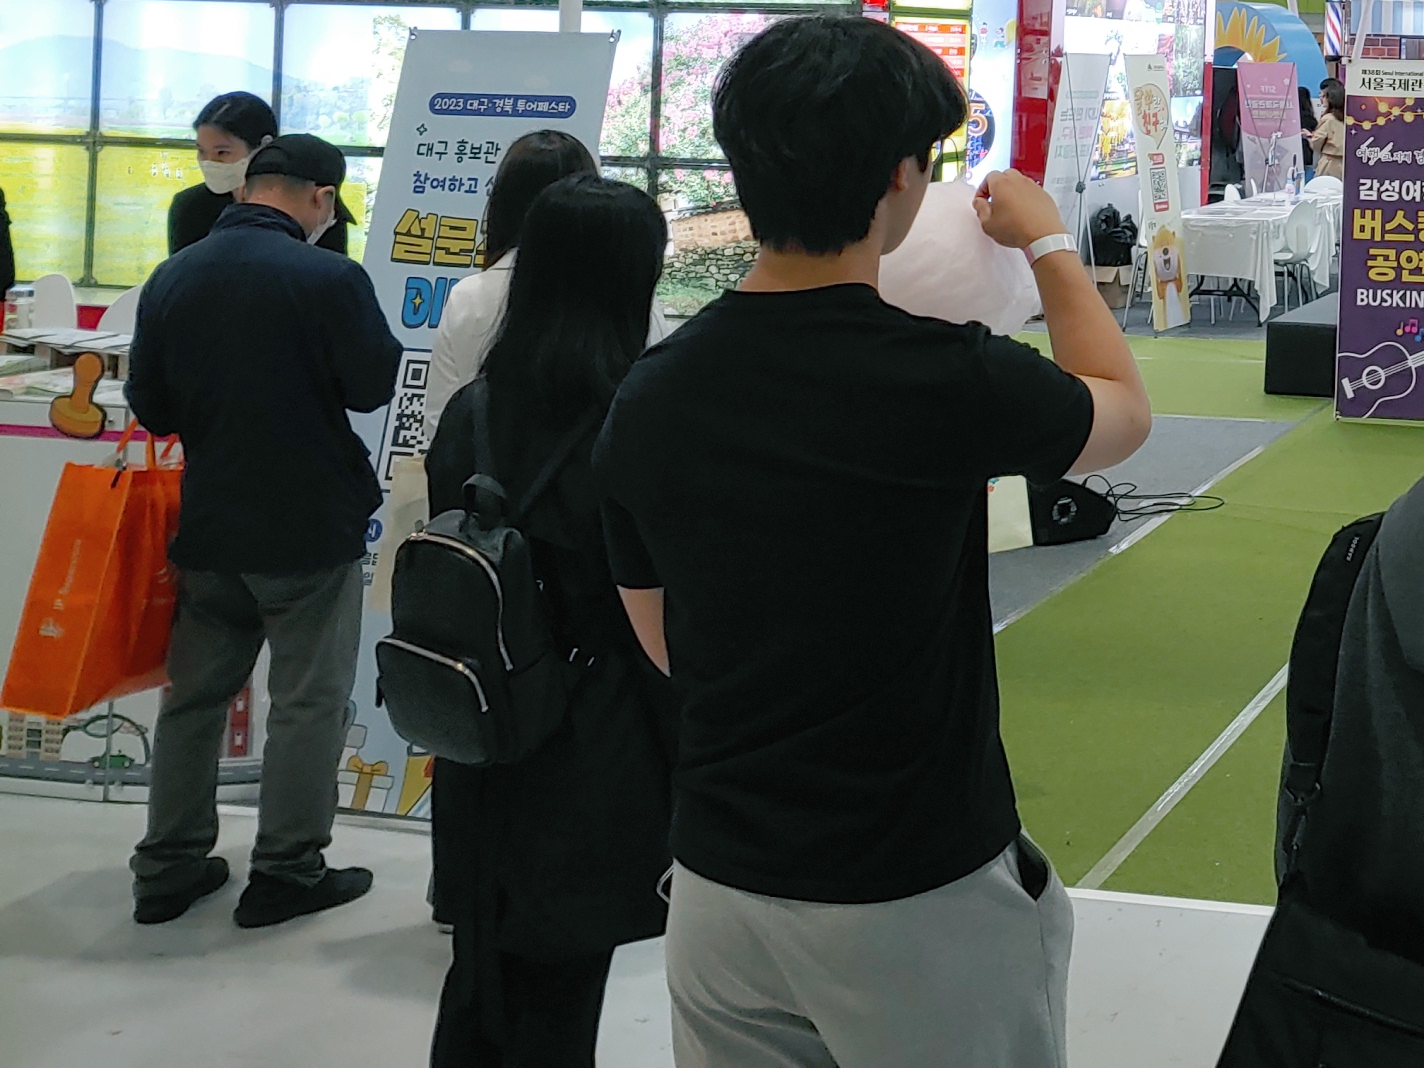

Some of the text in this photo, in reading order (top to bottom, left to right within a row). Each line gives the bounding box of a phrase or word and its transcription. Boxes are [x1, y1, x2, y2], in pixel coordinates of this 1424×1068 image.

[434, 97, 571, 114] 2023 대구·경북 투어페스타
[416, 140, 449, 162] 대구
[412, 171, 478, 195] 참여하고
[391, 208, 485, 268] 설문
